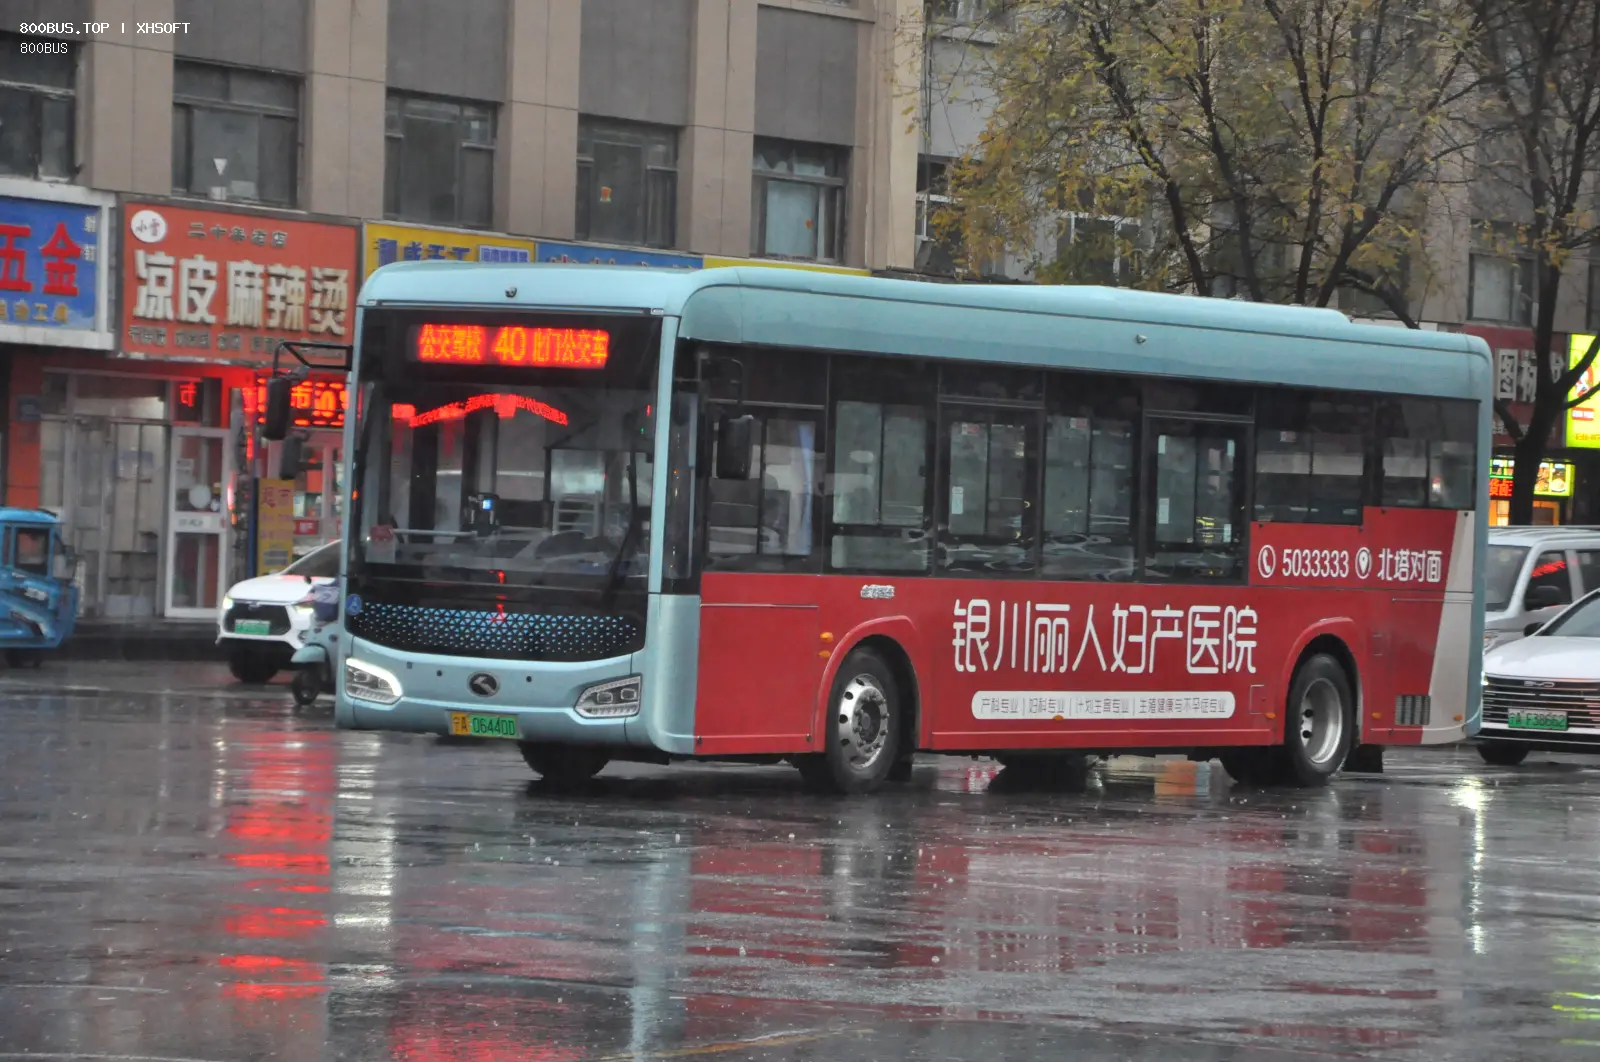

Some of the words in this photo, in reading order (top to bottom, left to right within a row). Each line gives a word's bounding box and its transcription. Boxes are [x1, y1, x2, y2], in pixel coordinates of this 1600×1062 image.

[492, 326, 527, 361] 40
[1281, 548, 1350, 578] 5033333
[1377, 547, 1443, 583] 北塔对面
[952, 598, 1258, 674] 银川丽人妇产医院
